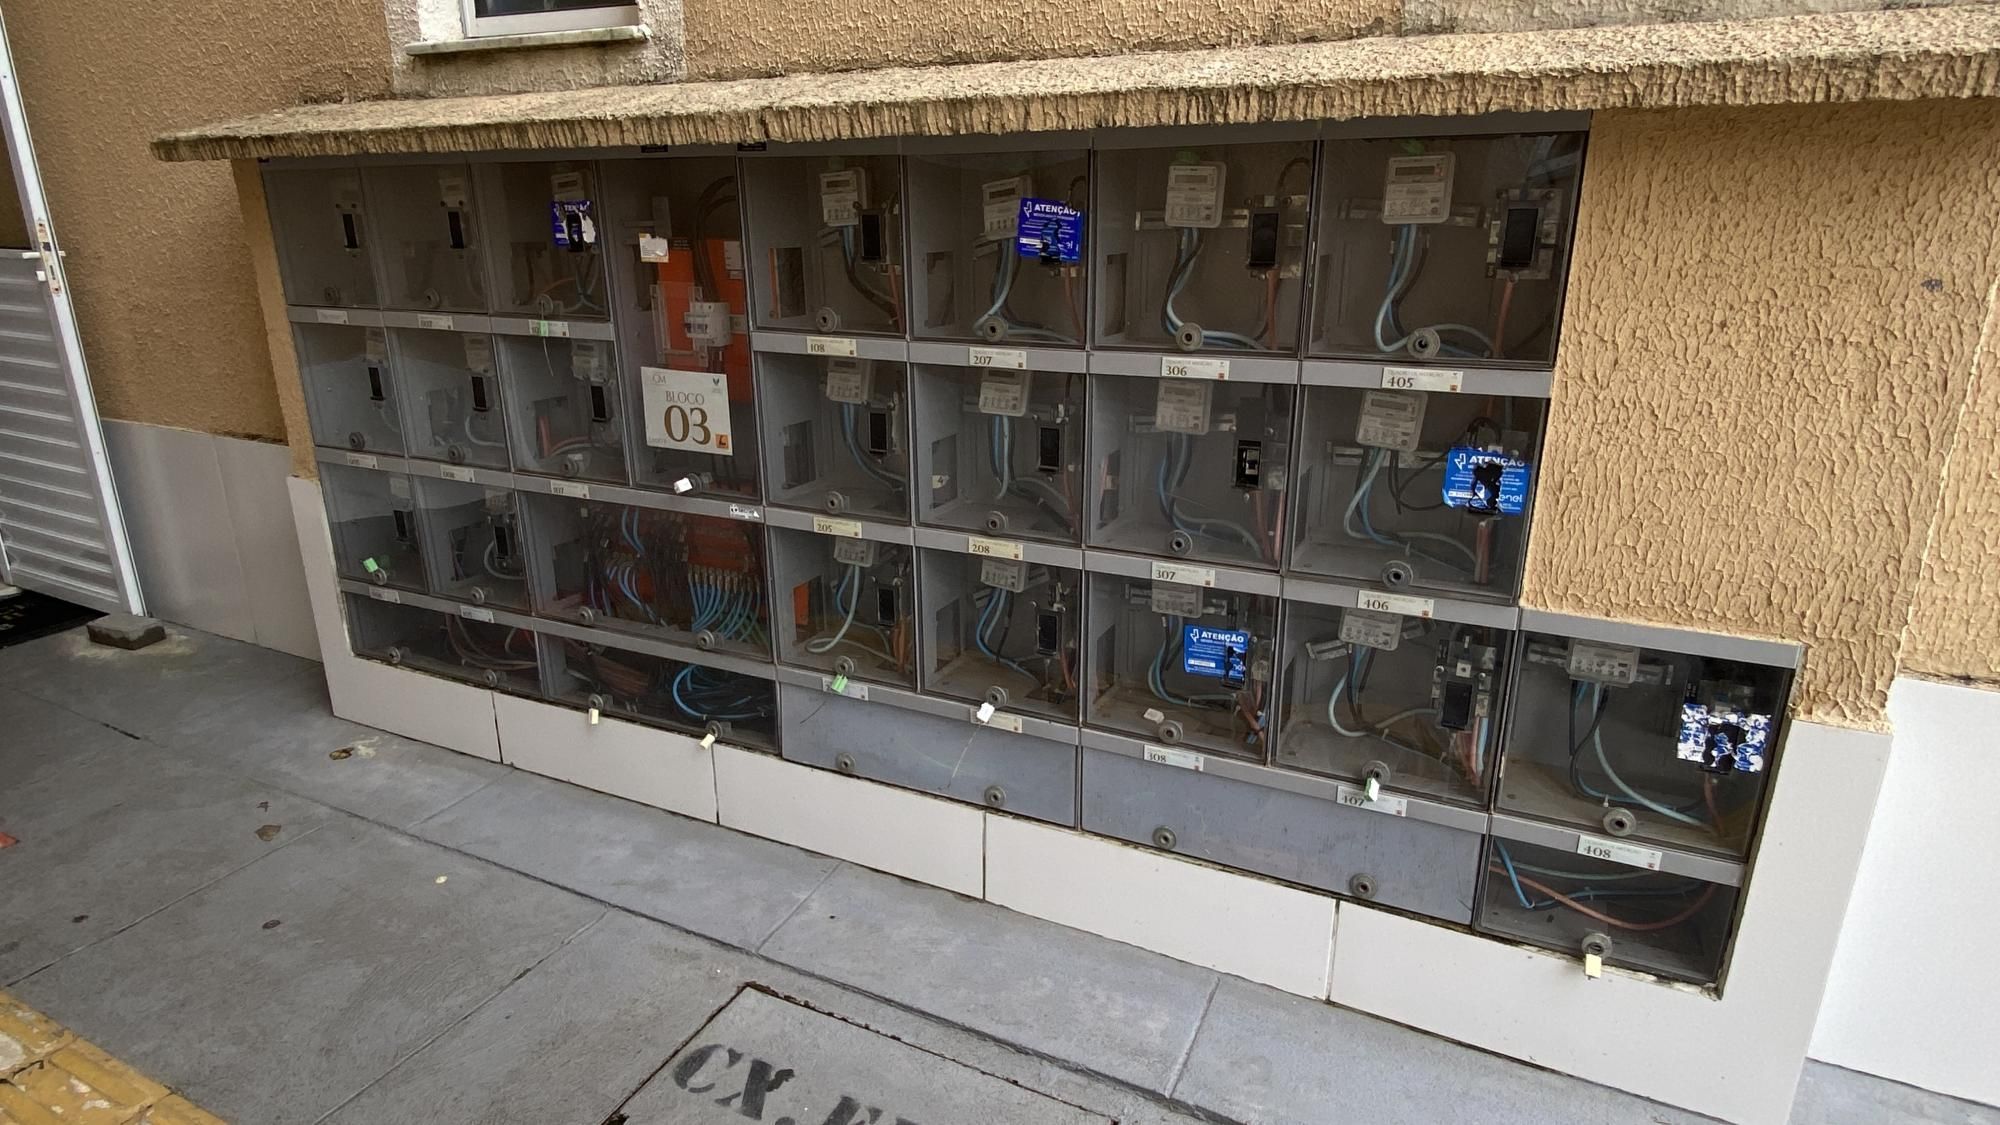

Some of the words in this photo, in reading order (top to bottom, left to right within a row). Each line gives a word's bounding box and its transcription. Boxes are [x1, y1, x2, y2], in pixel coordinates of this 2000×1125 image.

[810, 343, 825, 353] 108
[973, 355, 993, 366] 207
[1166, 365, 1187, 376] 306
[1387, 376, 1414, 388] 405
[665, 391, 705, 405] BLOCO
[664, 404, 711, 445] 03
[1499, 494, 1523, 503] enel
[972, 543, 990, 554] 208
[1155, 569, 1176, 581] 307
[1364, 599, 1389, 611] 406
[1201, 630, 1245, 643] ATENÇÃO
[1584, 845, 1612, 859] 408
